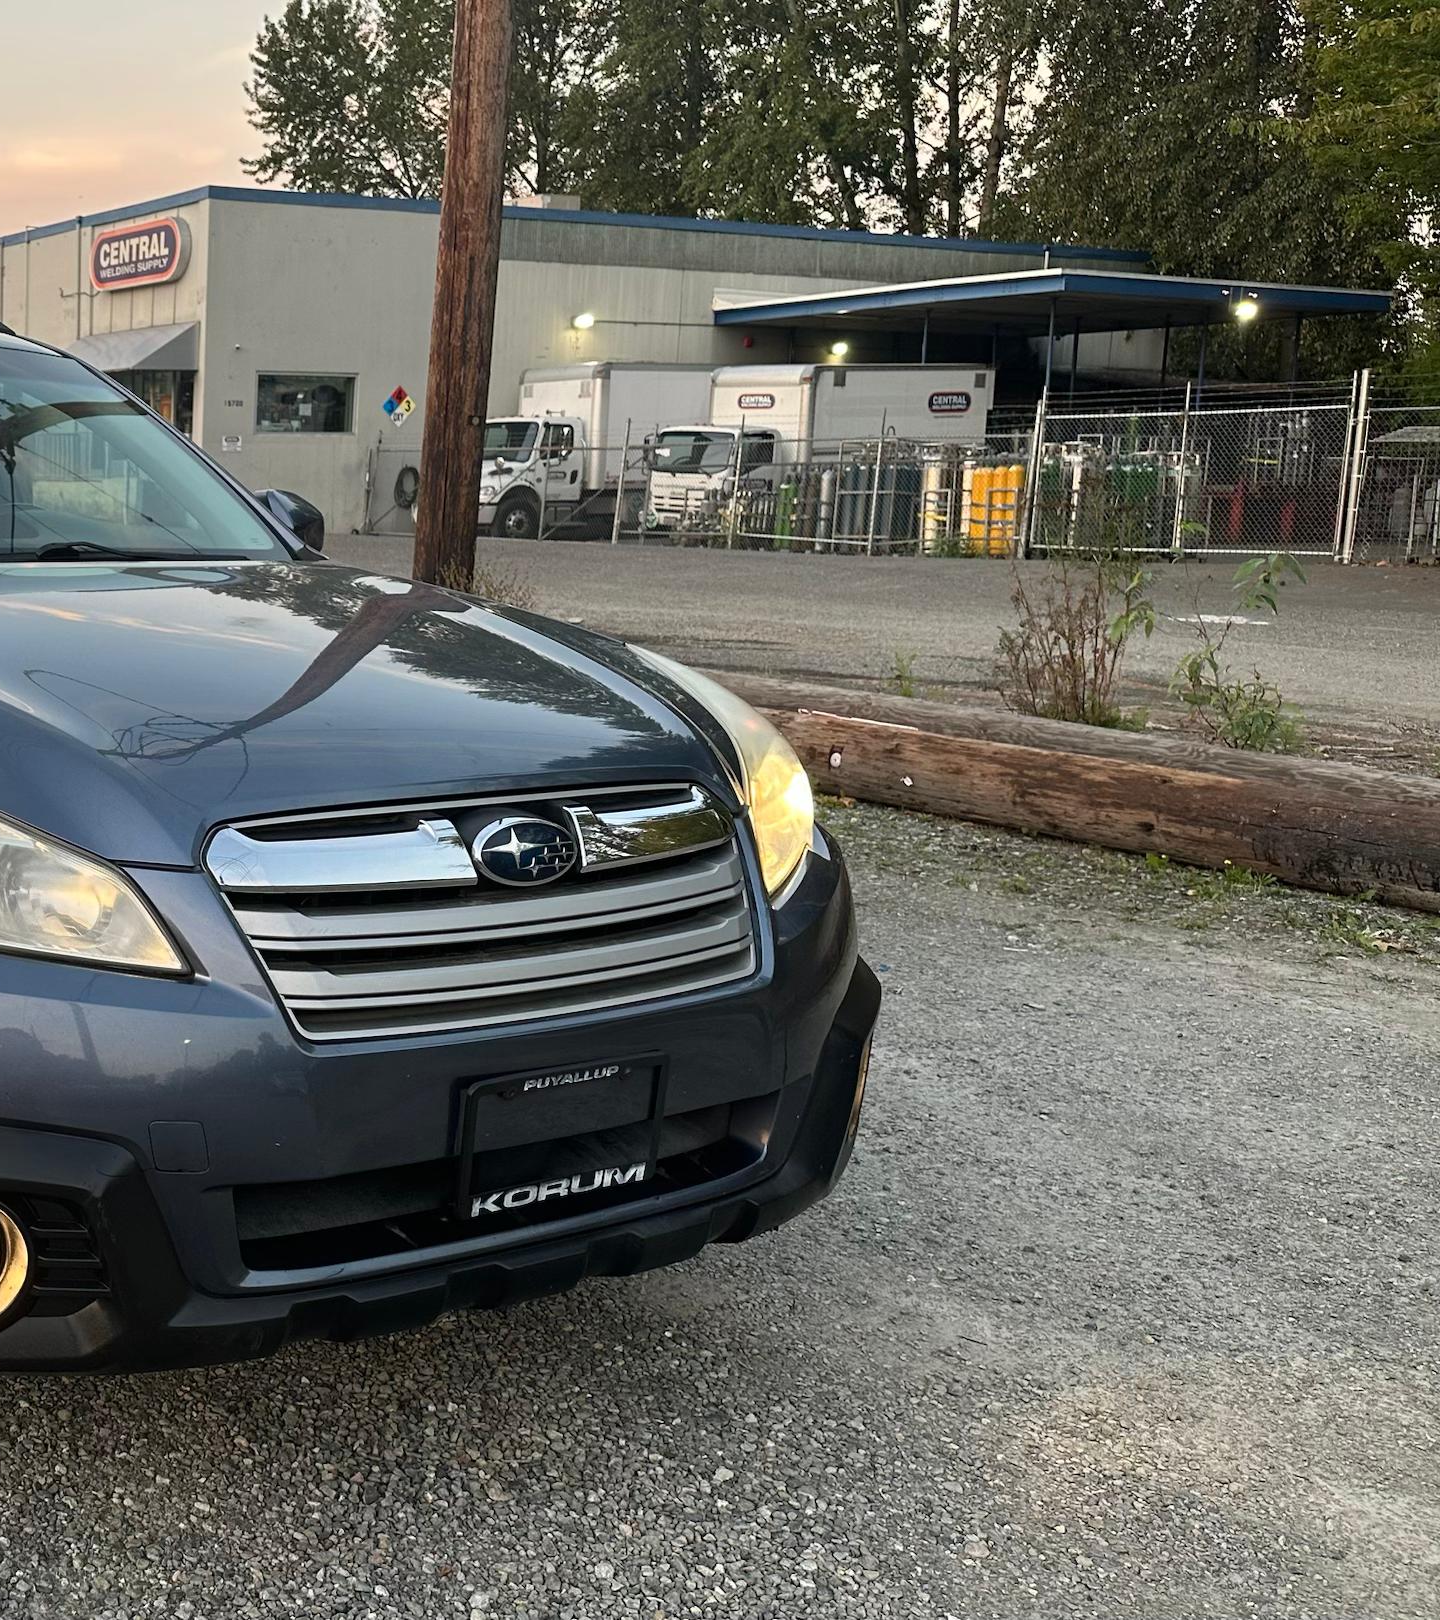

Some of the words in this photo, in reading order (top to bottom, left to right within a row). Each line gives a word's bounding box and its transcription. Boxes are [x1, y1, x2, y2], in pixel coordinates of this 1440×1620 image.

[99, 231, 170, 268] CENTRAL
[99, 263, 136, 279] WELDING
[137, 257, 169, 272] SUPPLY
[404, 399, 411, 413] 3
[932, 395, 968, 405] CENTRAL
[522, 1065, 620, 1092] PUYALLUP
[470, 1162, 647, 1218] KORUM
